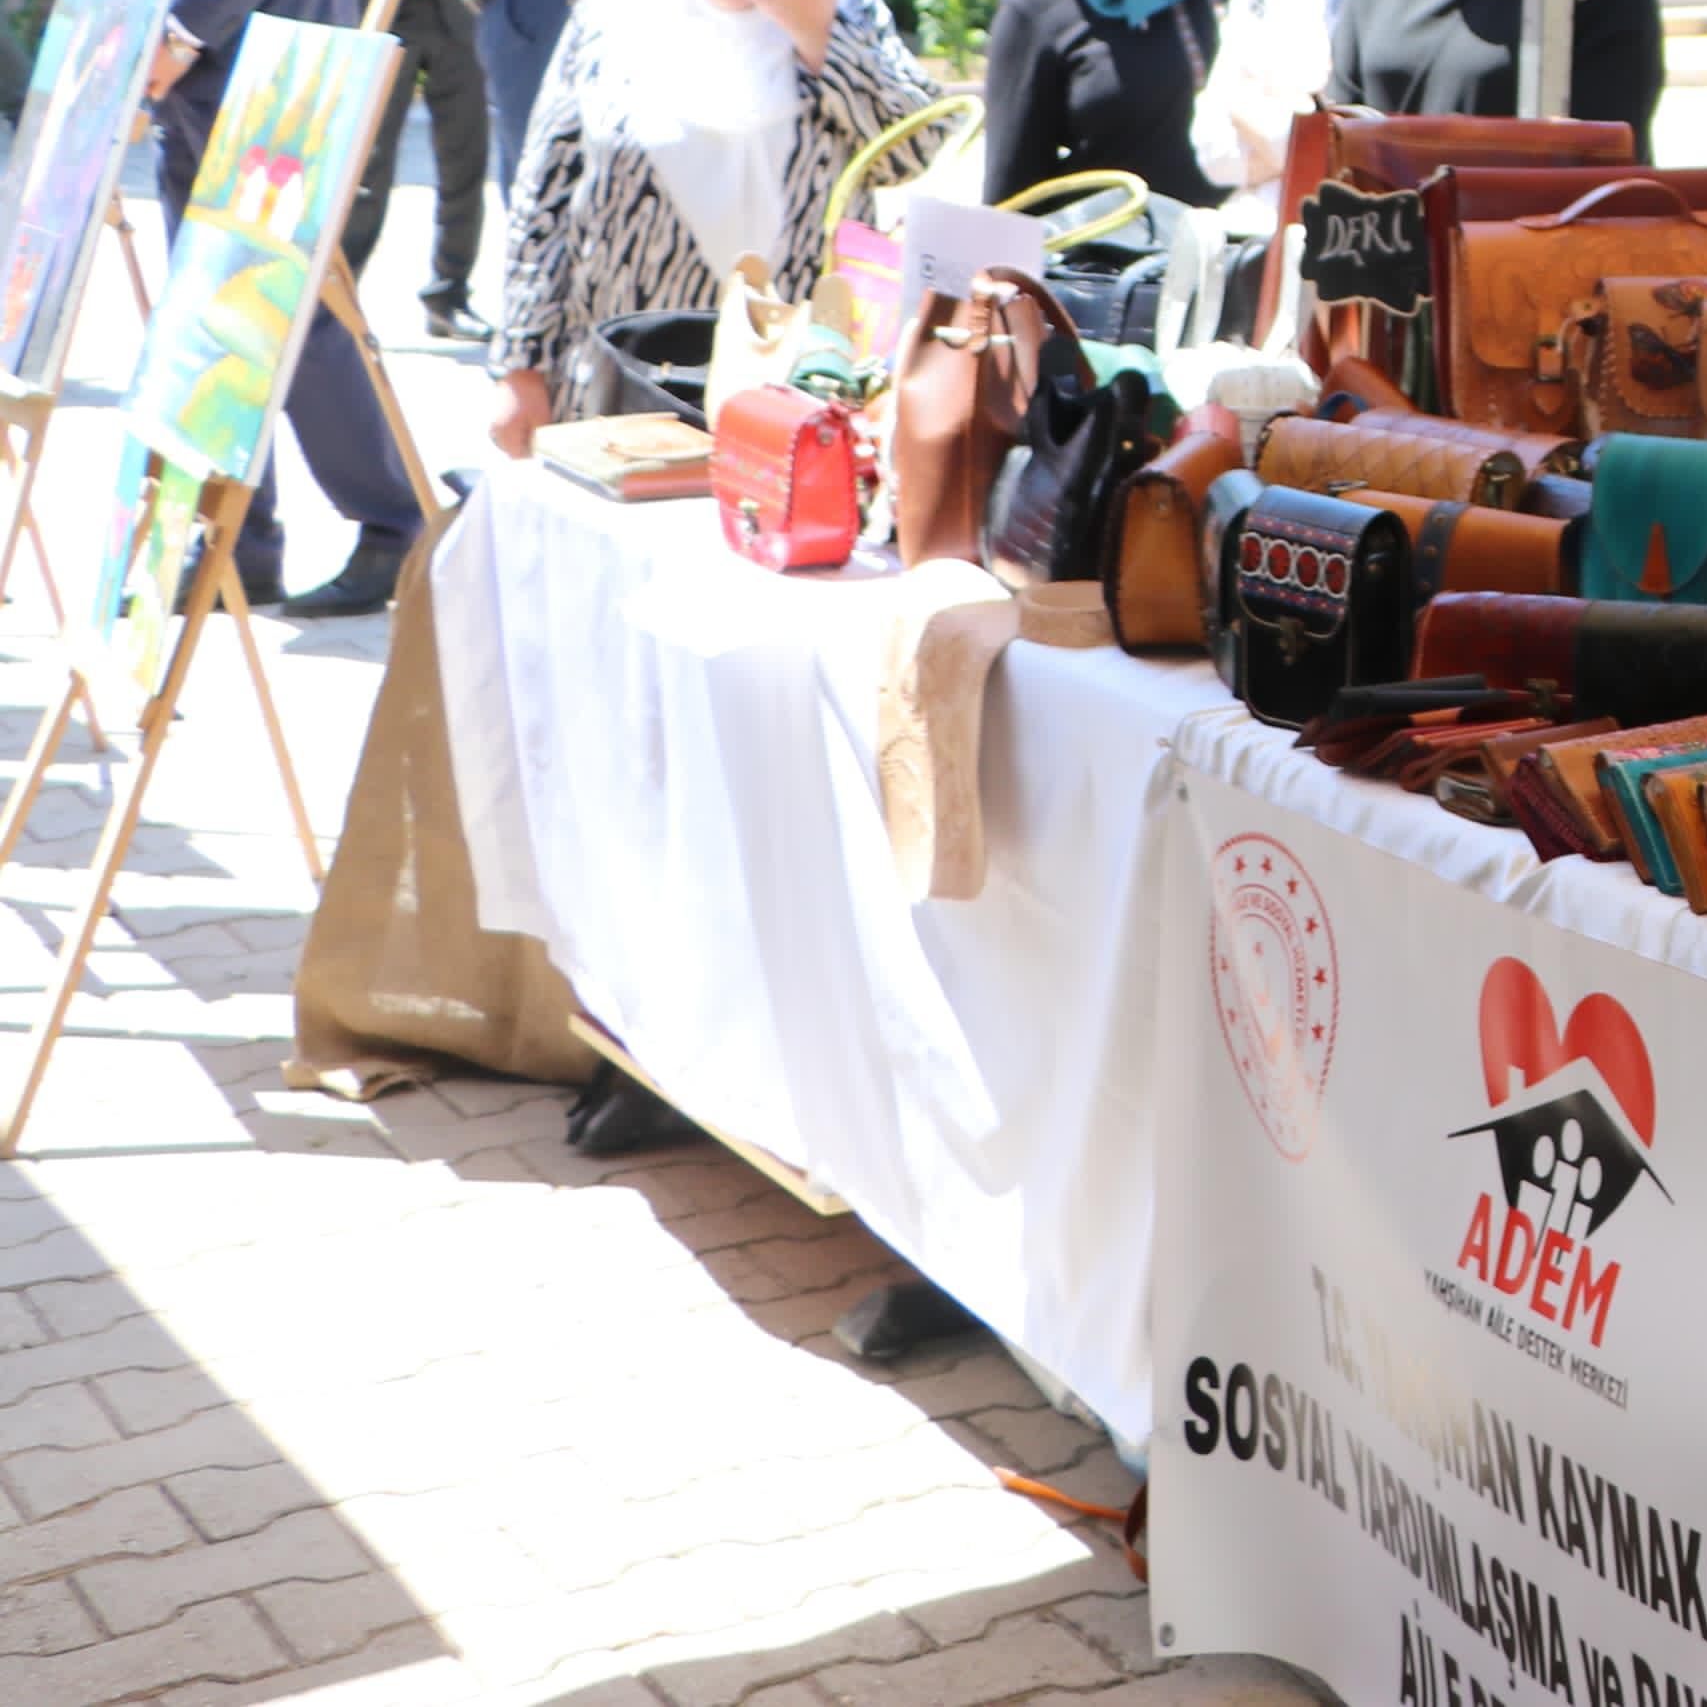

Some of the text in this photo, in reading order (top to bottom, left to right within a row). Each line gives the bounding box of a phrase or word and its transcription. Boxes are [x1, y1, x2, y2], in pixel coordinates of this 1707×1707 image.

[1457, 1191, 1622, 1349] ADEM
[1485, 1304, 1516, 1344] AİLE
[1516, 1324, 1566, 1375] DESTEK
[1569, 1351, 1630, 1411] MERKEZİ
[1184, 1356, 1347, 1514] SOSYAL
[1346, 1427, 1574, 1706] YARDIMLAŞMA
